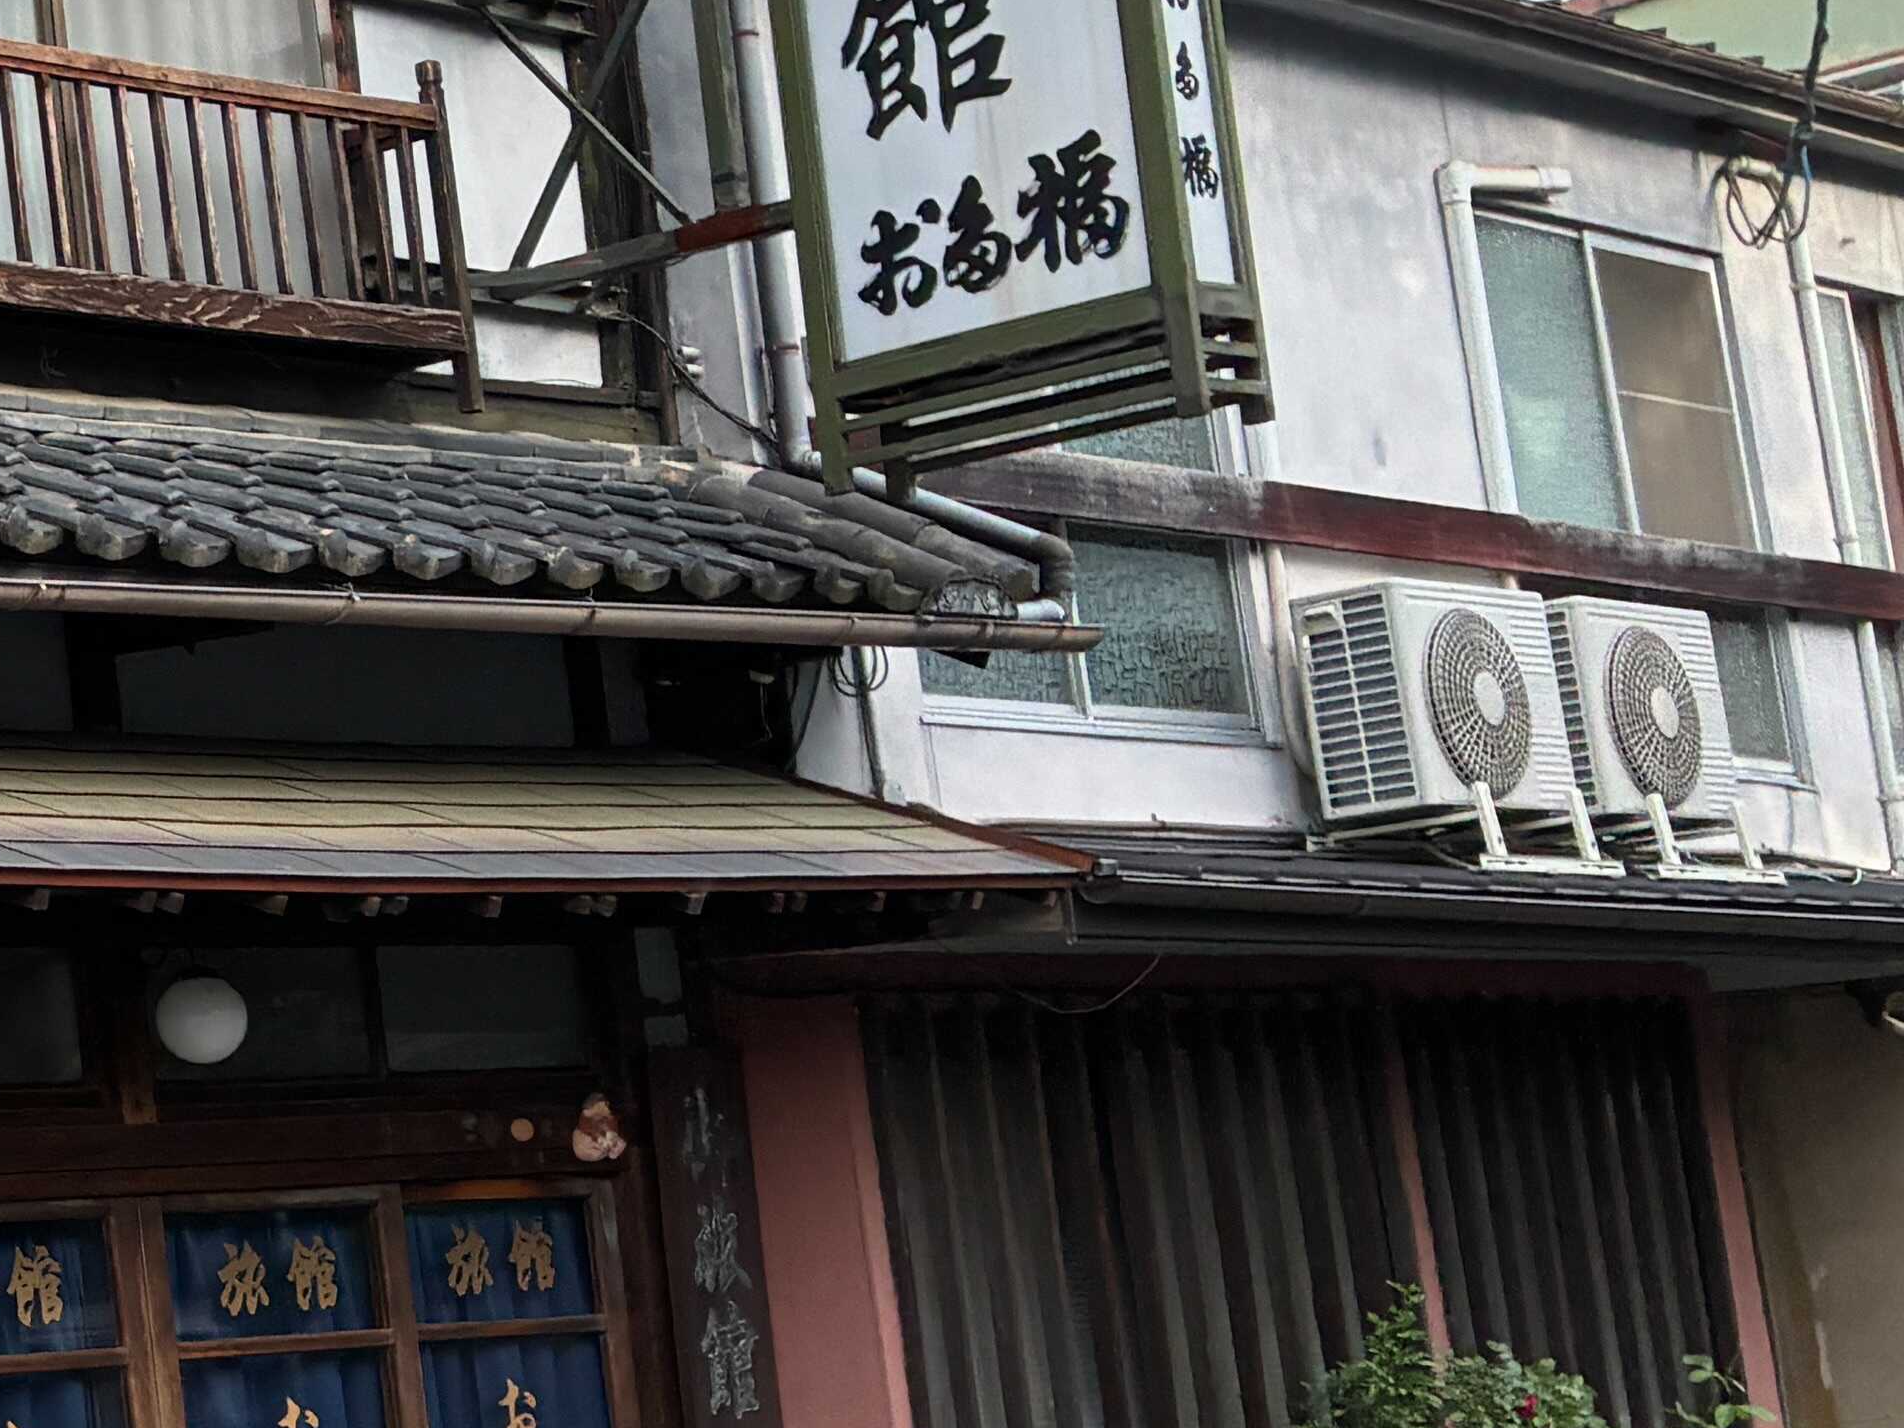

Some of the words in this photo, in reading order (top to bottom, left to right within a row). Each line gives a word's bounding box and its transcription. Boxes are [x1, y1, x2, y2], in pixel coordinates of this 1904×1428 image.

[857, 128, 1130, 317] お多福
[218, 1234, 340, 1317] 旅館
[445, 1221, 556, 1298] 旅館
